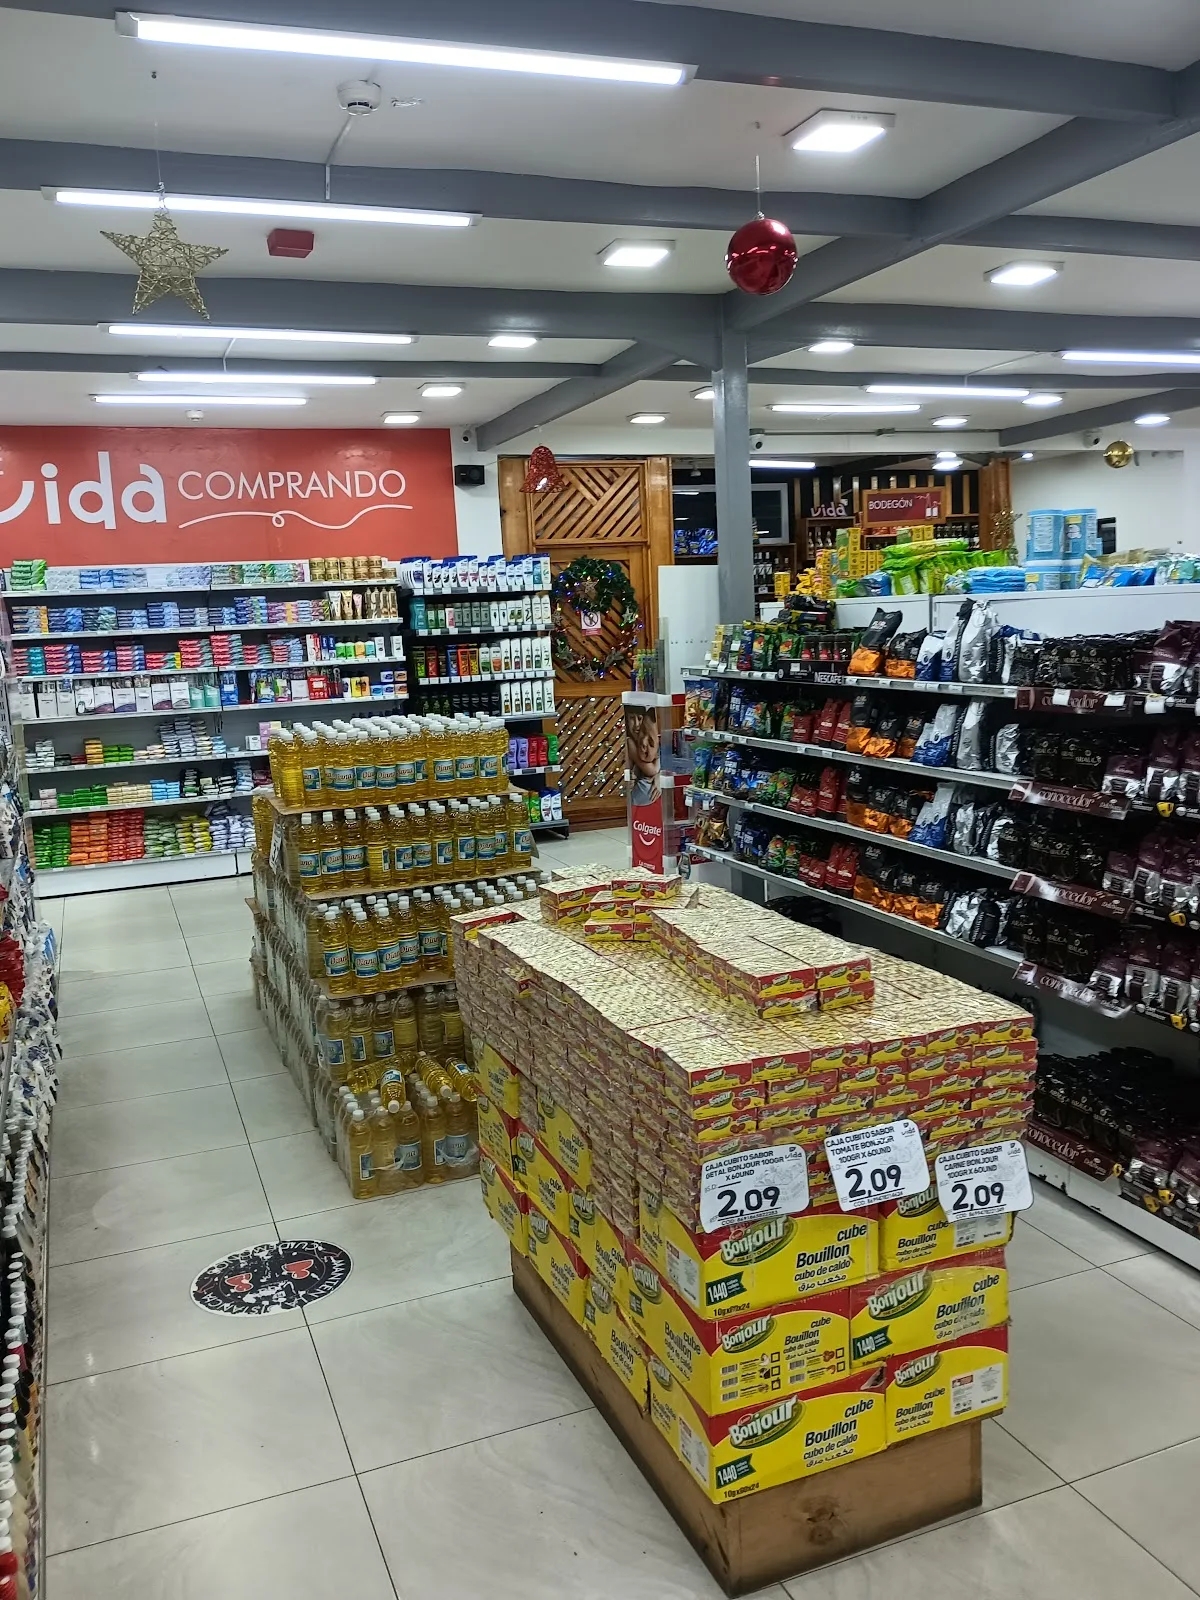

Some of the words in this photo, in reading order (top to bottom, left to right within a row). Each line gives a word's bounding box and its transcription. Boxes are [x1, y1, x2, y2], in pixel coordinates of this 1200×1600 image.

[177, 469, 407, 501] COMPRANDO
[868, 497, 913, 511] BODEGÓN
[1038, 790, 1096, 809] conocedor
[633, 820, 663, 837] Colgate
[826, 1138, 845, 1148] CAJA
[845, 1131, 871, 1143] CUBITO
[871, 1125, 895, 1137] SABOR
[831, 1144, 860, 1156] TOMATE
[939, 1154, 955, 1164] CAJA
[955, 1149, 980, 1160] CUBITO
[980, 1146, 1003, 1156] SABOR
[705, 1161, 723, 1172] CAJA
[723, 1155, 749, 1168] CUBITO
[749, 1150, 774, 1161] SABOR
[727, 1160, 760, 1173] BONJOUR
[845, 1165, 902, 1198] 2,09
[717, 1186, 780, 1218] 2,09
[951, 1182, 1005, 1211] 2,09
[837, 1223, 868, 1243] cube
[927, 1219, 949, 1233] cube
[720, 1215, 788, 1260] Bonjour
[897, 1232, 937, 1249] Bouillon
[796, 1244, 850, 1268] Bouillon
[707, 1282, 728, 1304] 1440
[866, 1266, 929, 1316] Bonjour
[973, 1273, 999, 1293] cube
[936, 1294, 985, 1319] Bouillon
[721, 1313, 772, 1349] Bonjour
[811, 1316, 831, 1329] cube
[664, 1321, 693, 1361] Bouillon
[683, 1331, 702, 1356] cube
[785, 1329, 819, 1346] Bouillon
[856, 1335, 875, 1356] 1440
[894, 1350, 939, 1385] Bonjour
[924, 1387, 946, 1400] cube
[844, 1398, 874, 1418] cube
[895, 1401, 933, 1419] Bouillon
[728, 1395, 798, 1446] Bonjour
[805, 1419, 857, 1447] Bouillon
[717, 1464, 737, 1485] 1440
